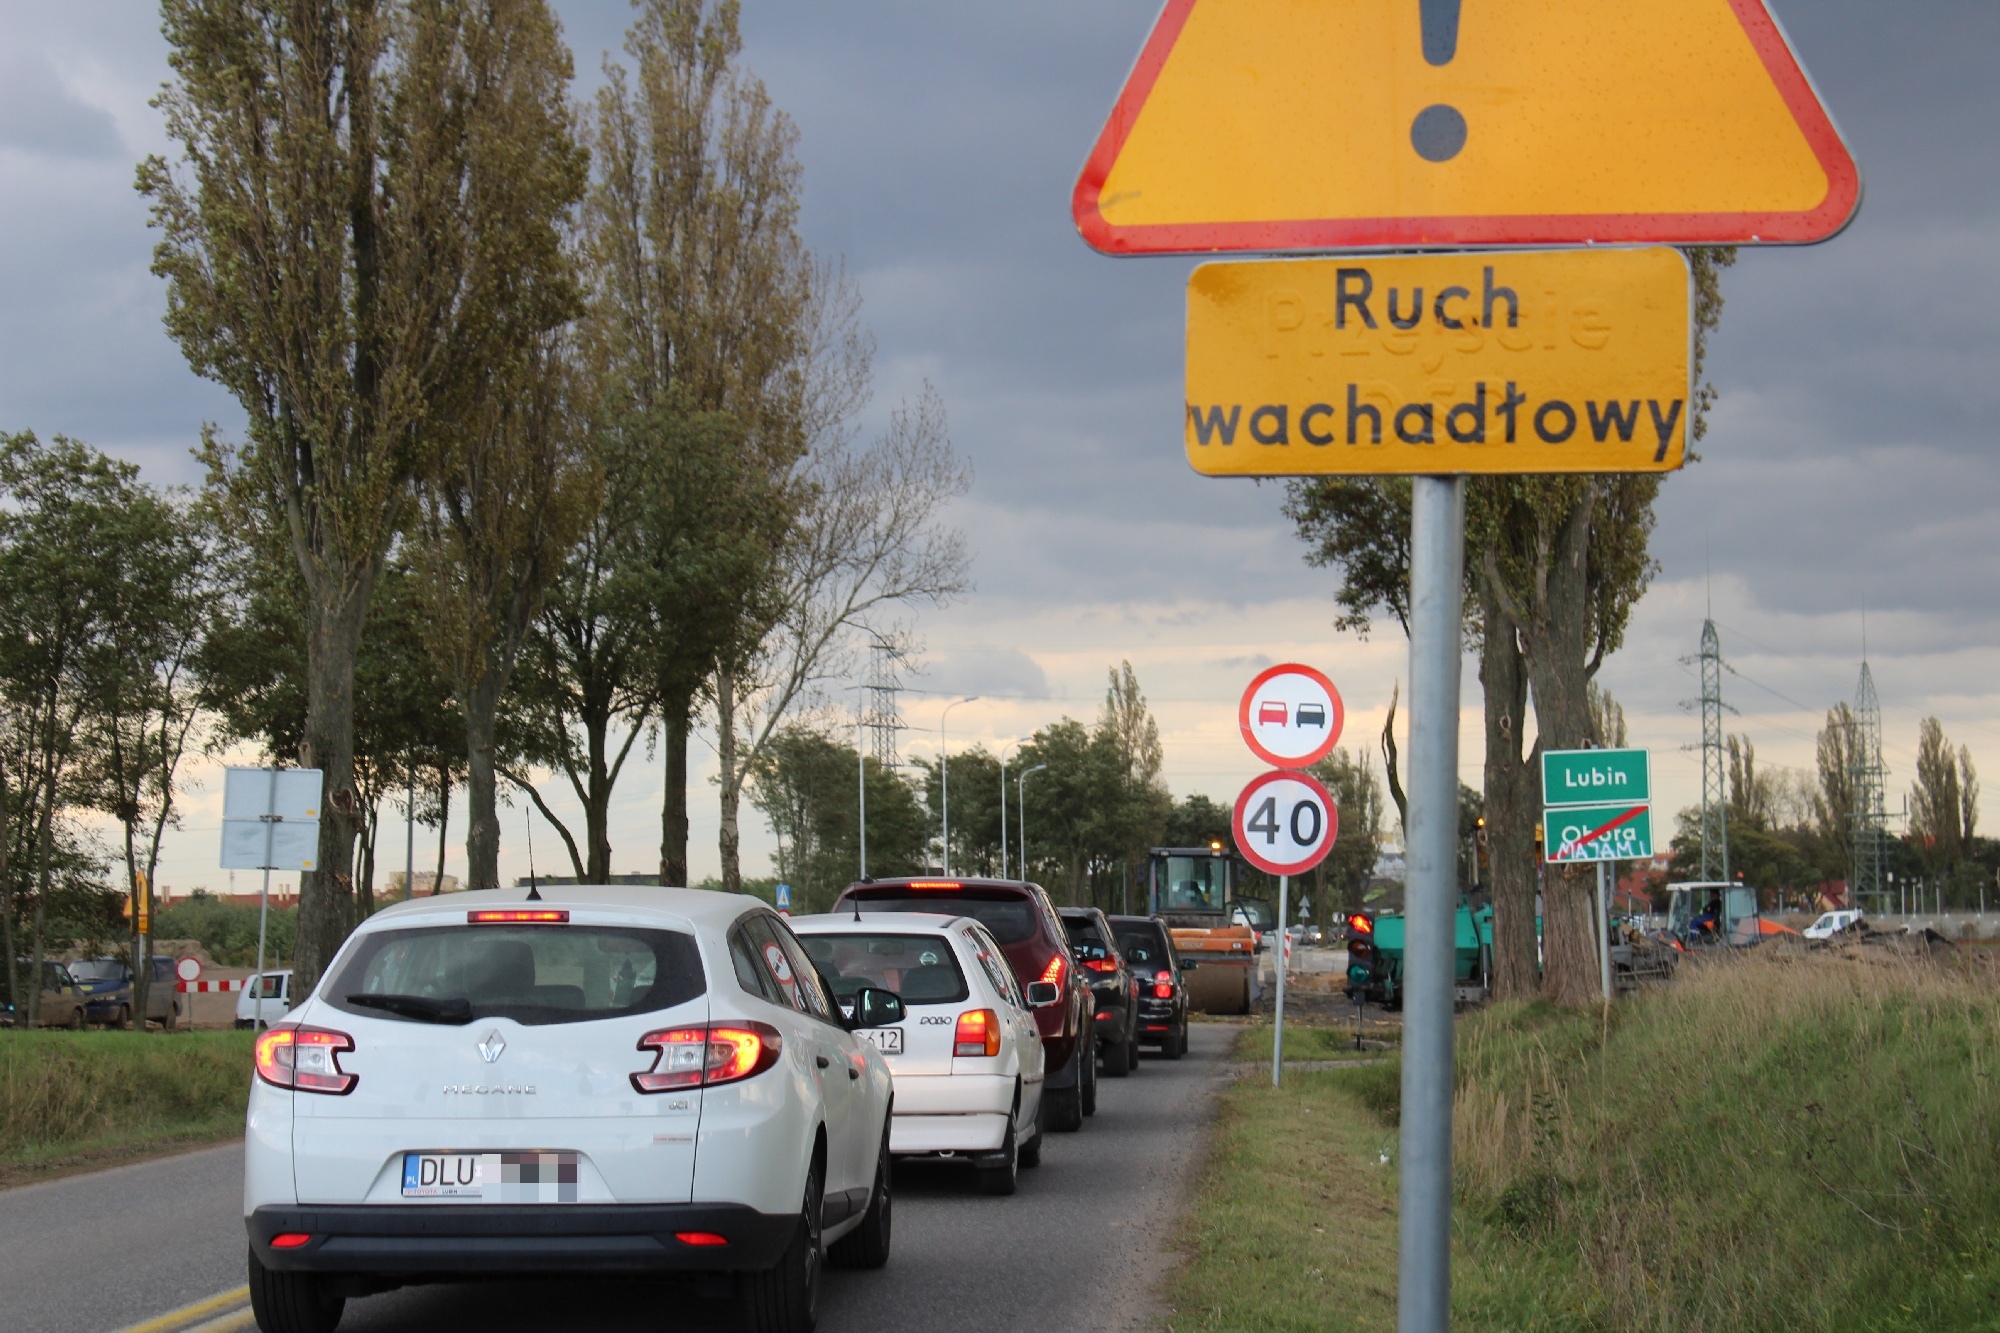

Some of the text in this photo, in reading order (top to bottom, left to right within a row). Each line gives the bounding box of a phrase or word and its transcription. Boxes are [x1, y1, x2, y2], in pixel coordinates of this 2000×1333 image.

[1334, 266, 1519, 330] Ruch
[1187, 380, 1684, 463] wachadłowy
[1565, 767, 1627, 787] Lubin
[1247, 797, 1321, 846] 40
[443, 1084, 537, 1095] MEGANE
[406, 1175, 417, 1185] PL
[420, 1157, 475, 1186] DLU
